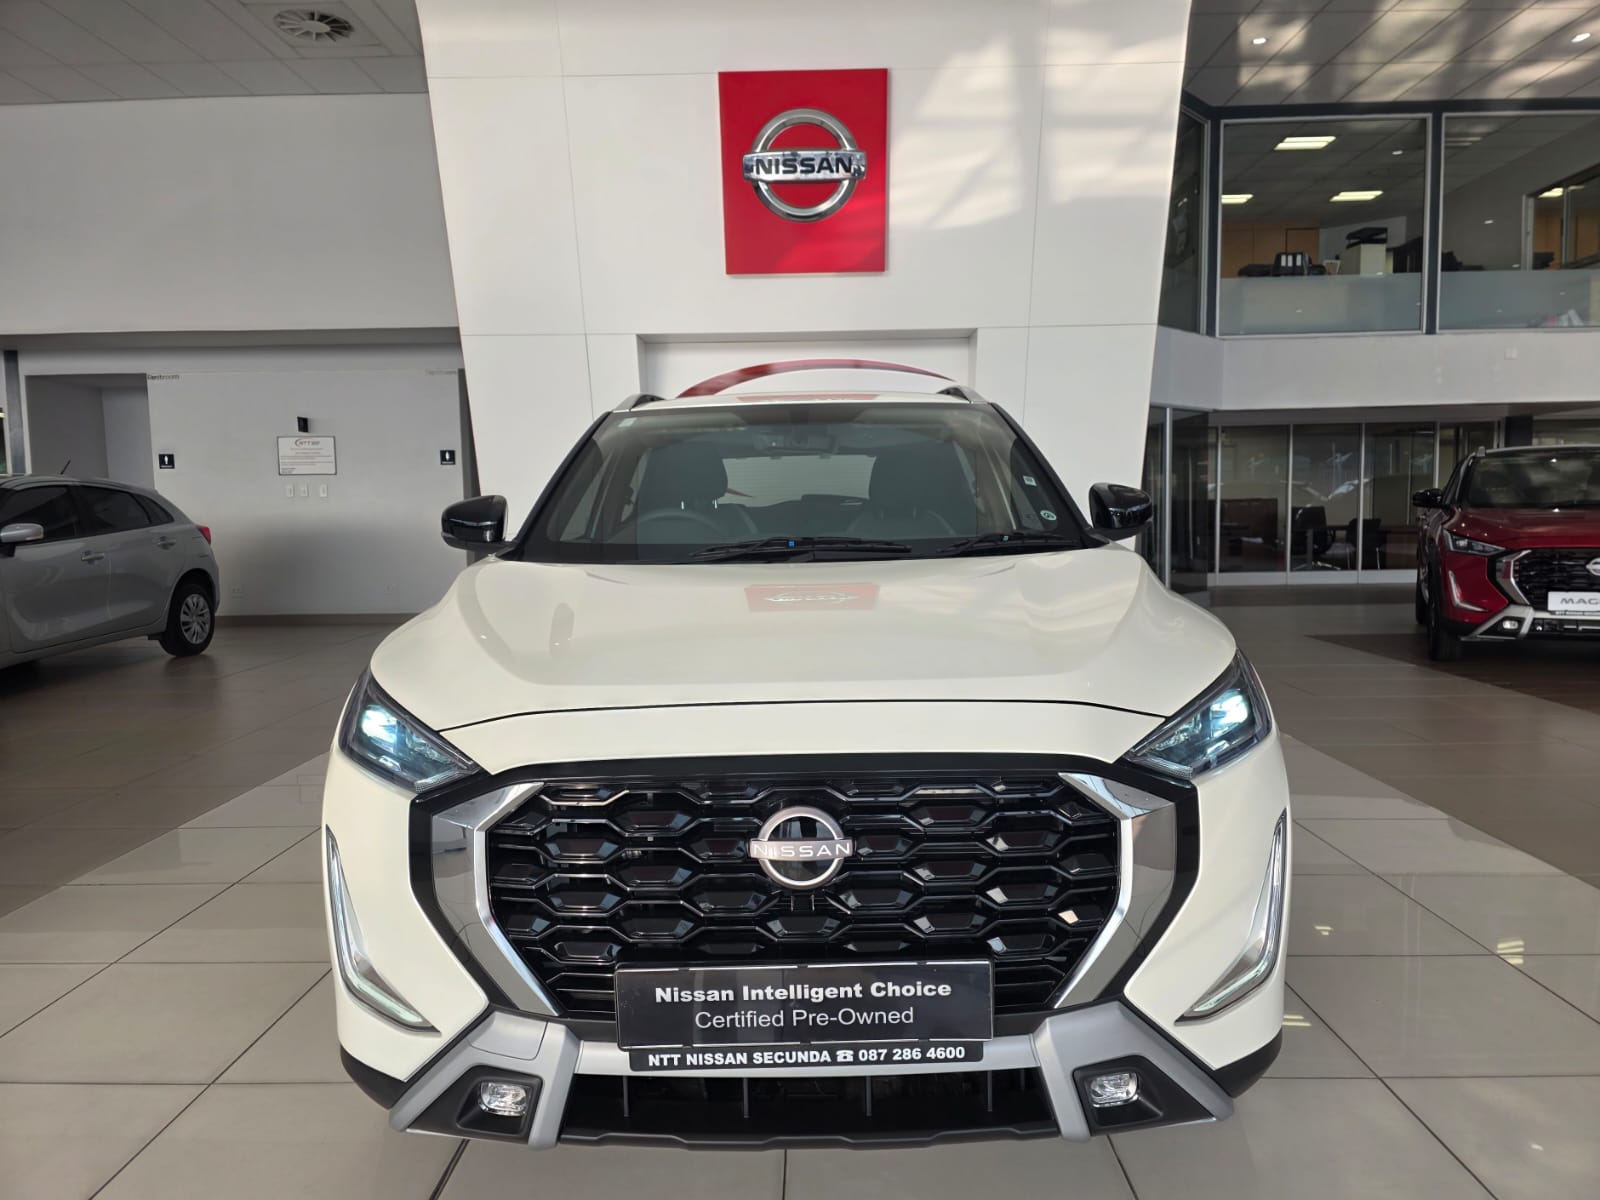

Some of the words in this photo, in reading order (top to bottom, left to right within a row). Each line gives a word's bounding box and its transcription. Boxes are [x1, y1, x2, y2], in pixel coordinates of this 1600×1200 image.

[755, 157, 852, 175] NISSAN
[753, 842, 850, 857] NISSAN
[655, 987, 734, 1003] Nissan
[742, 983, 863, 1003] Intelligent
[870, 981, 952, 998] Choice
[695, 1010, 784, 1029] Certified
[792, 1006, 914, 1026] Pre-Owned
[648, 1053, 681, 1067] NTT
[686, 1052, 748, 1066] NISSAN
[752, 1050, 832, 1064] SECUNDA
[858, 1049, 887, 1061] 087
[892, 1047, 922, 1060] 286
[926, 1046, 966, 1060] 4600
